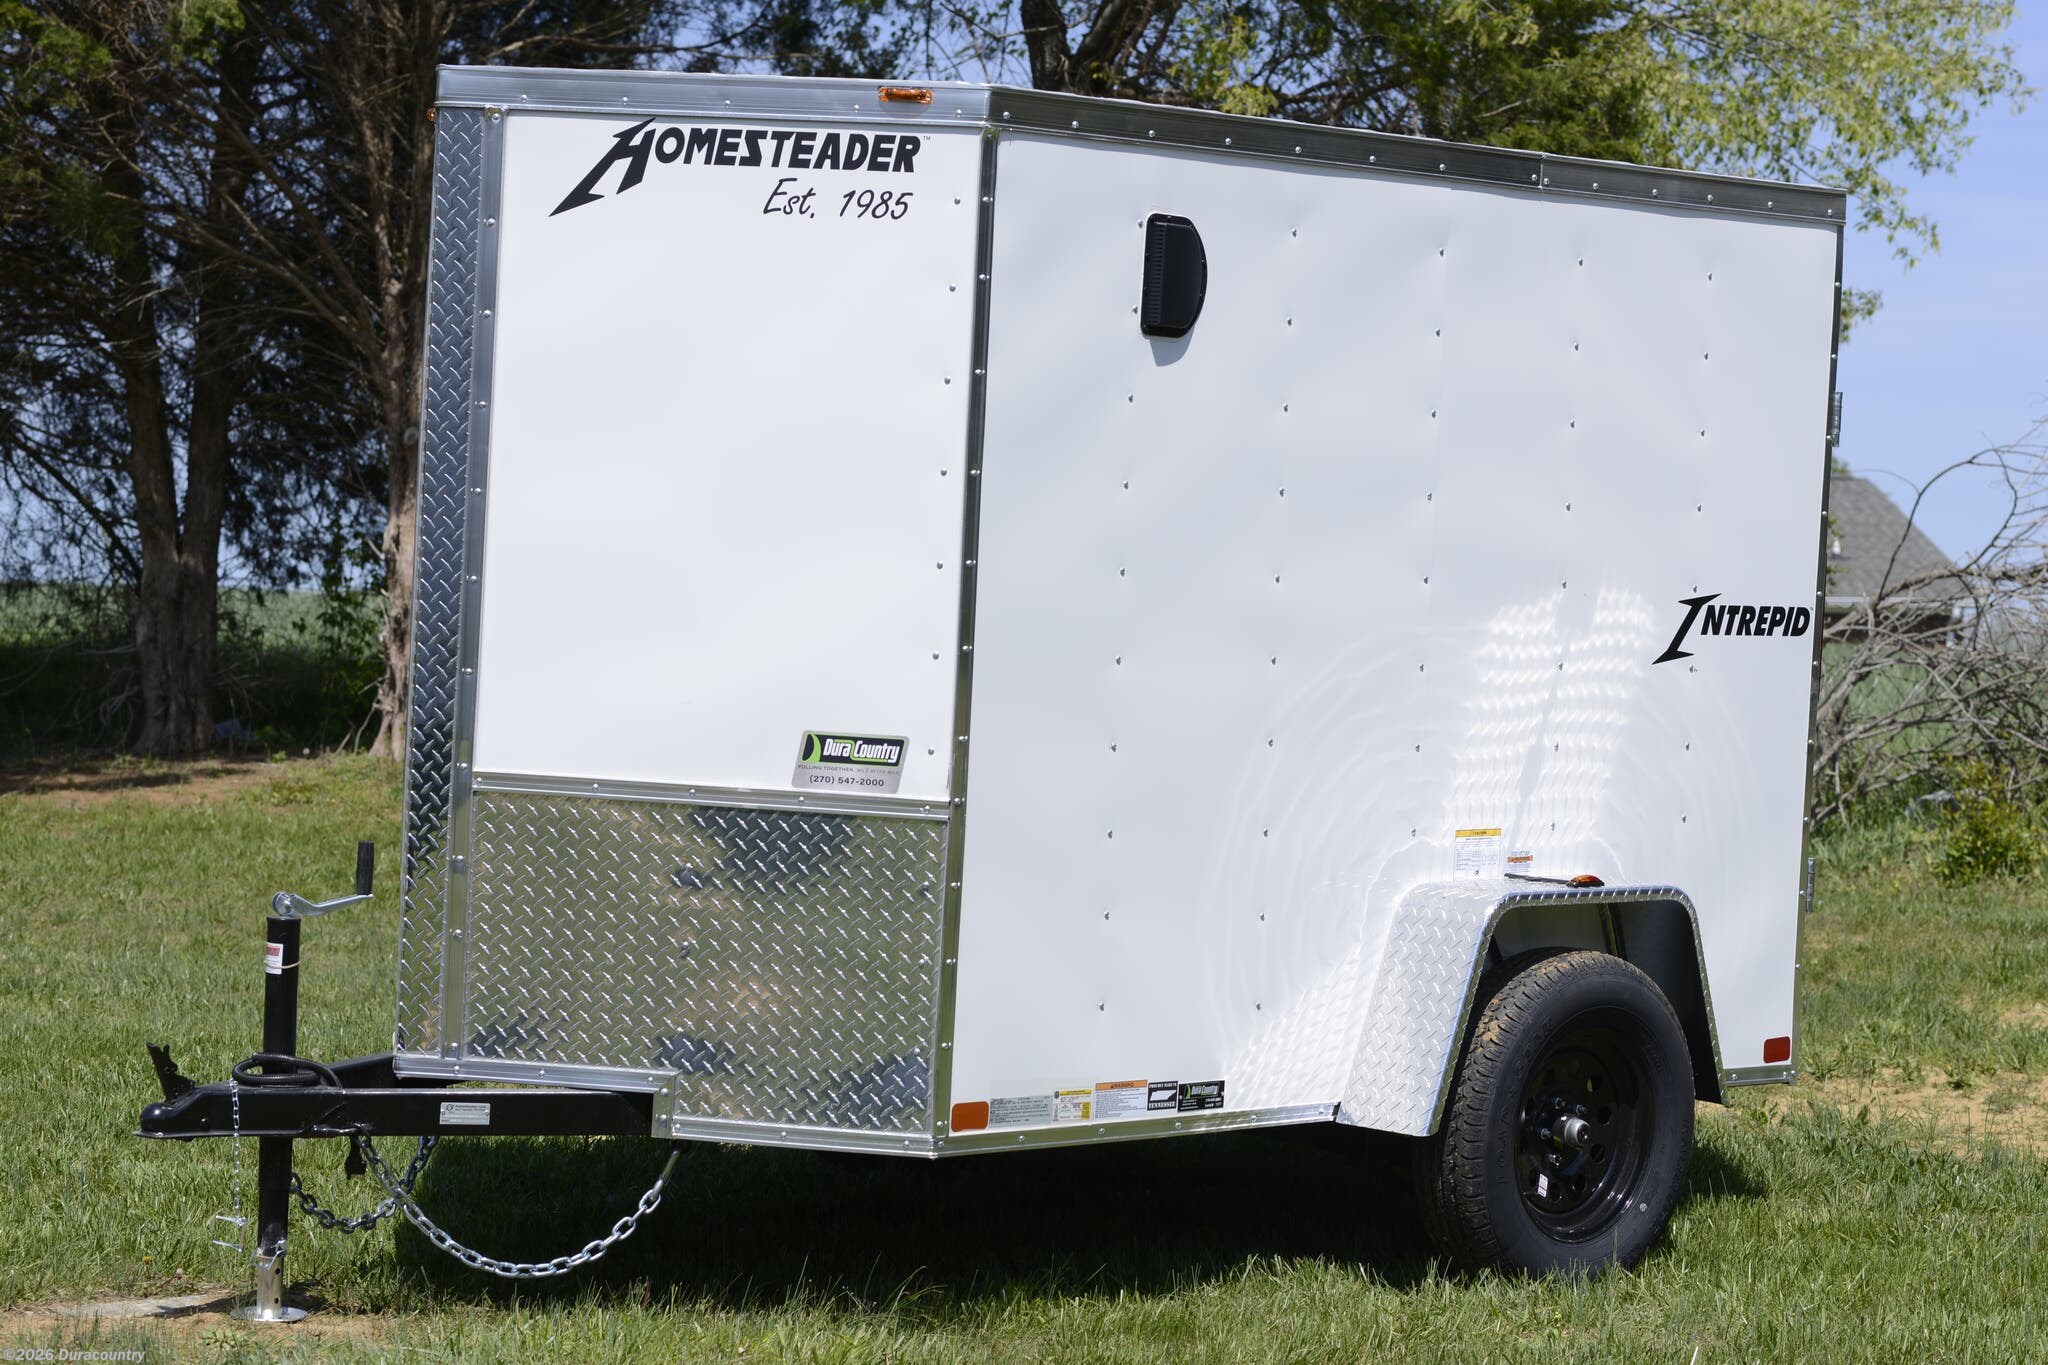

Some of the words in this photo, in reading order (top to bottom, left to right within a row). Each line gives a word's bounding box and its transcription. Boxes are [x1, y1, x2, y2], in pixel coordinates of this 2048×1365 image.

[549, 117, 921, 217] HOMESTEADER
[763, 178, 816, 219] Est.
[839, 189, 914, 221] 1985
[1651, 593, 1811, 665] INTREPID
[809, 774, 835, 784] (270)
[838, 776, 885, 787] 547-2000
[1148, 1101, 1176, 1109] TENNESSEE
